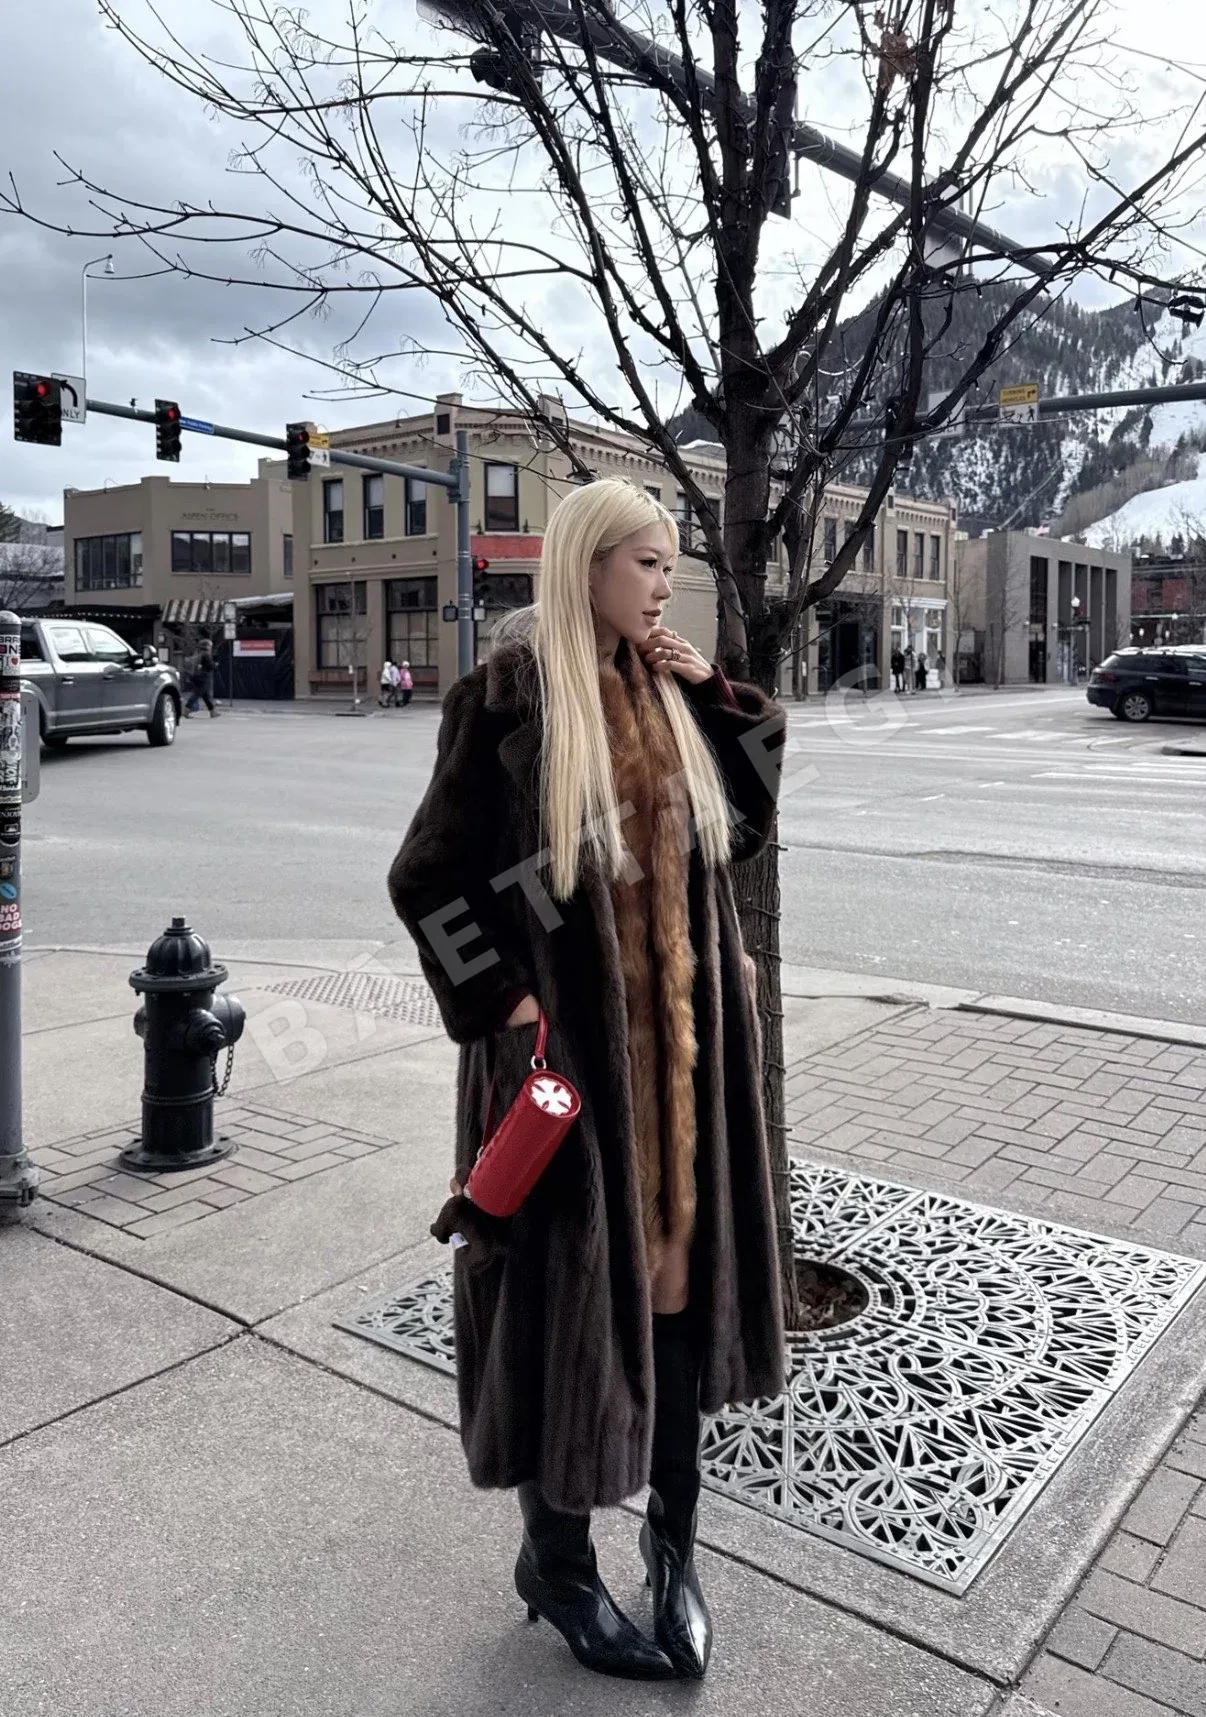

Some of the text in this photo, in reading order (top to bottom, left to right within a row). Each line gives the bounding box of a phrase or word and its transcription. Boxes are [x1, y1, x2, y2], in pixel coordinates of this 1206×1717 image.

[62, 409, 80, 419] NLY
[1, 903, 17, 913] NO
[0, 919, 22, 931] OGS
